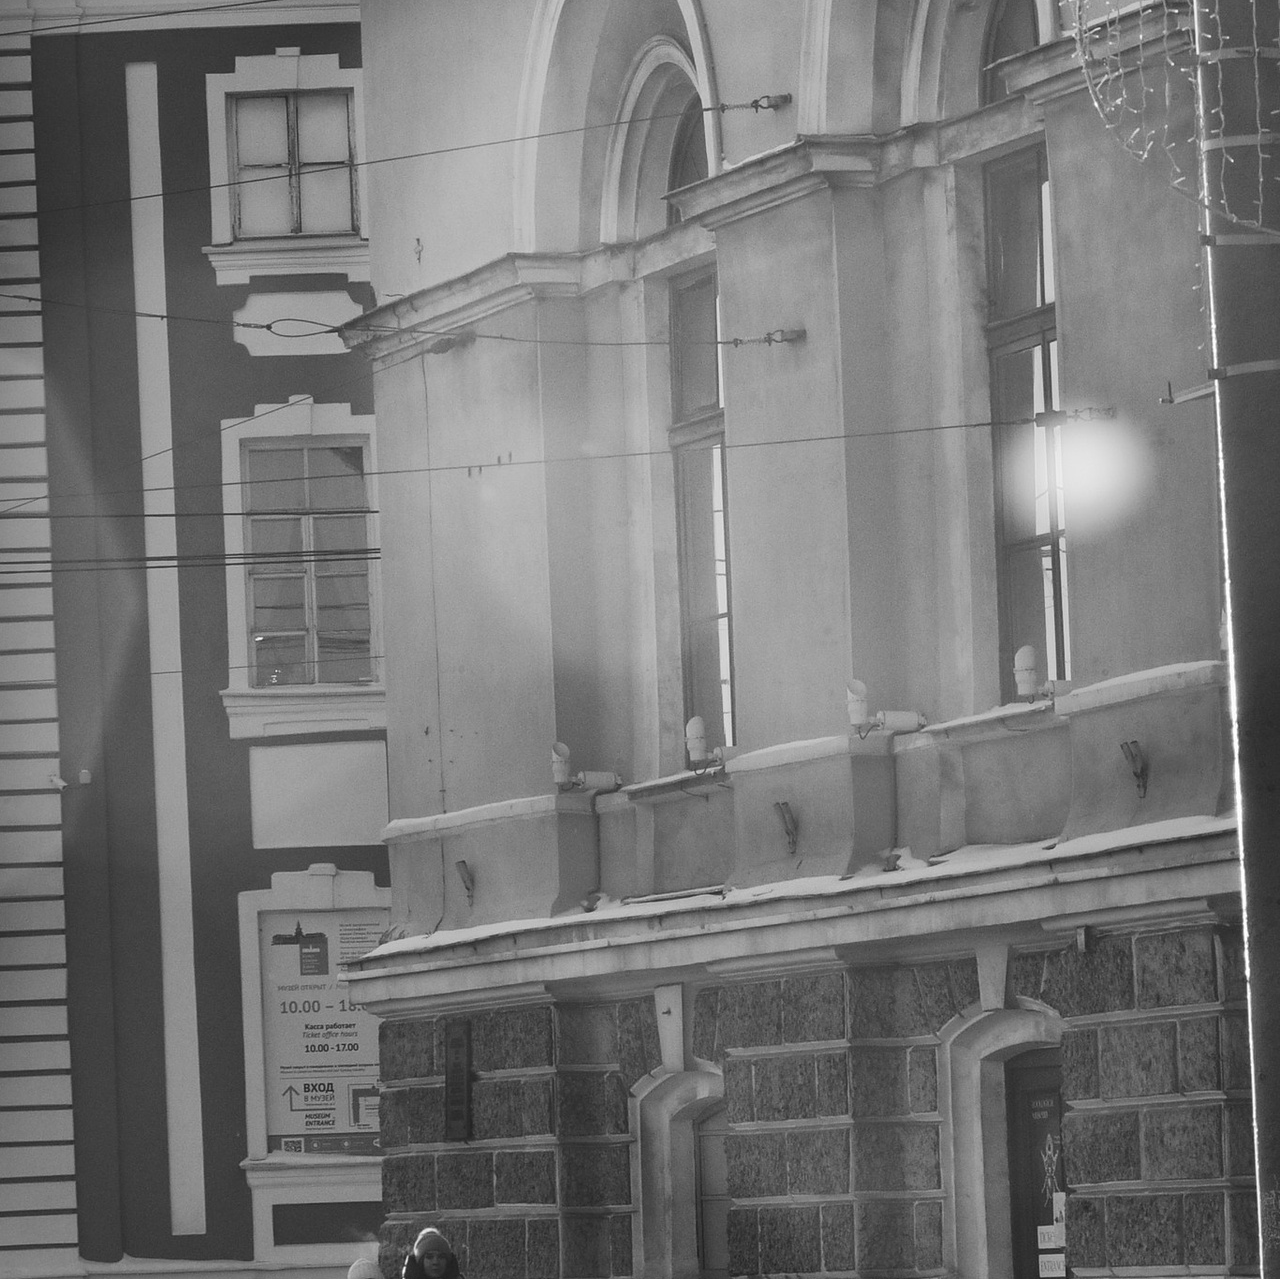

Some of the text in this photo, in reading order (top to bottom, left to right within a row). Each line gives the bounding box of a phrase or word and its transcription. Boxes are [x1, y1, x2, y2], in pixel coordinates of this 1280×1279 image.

[280, 1000, 320, 1014] 10.00
[326, 1022, 356, 1030] работает
[322, 1031, 339, 1039] office
[303, 1083, 335, 1093] ВХОД
[311, 1094, 335, 1102] МУЗЕЙ
